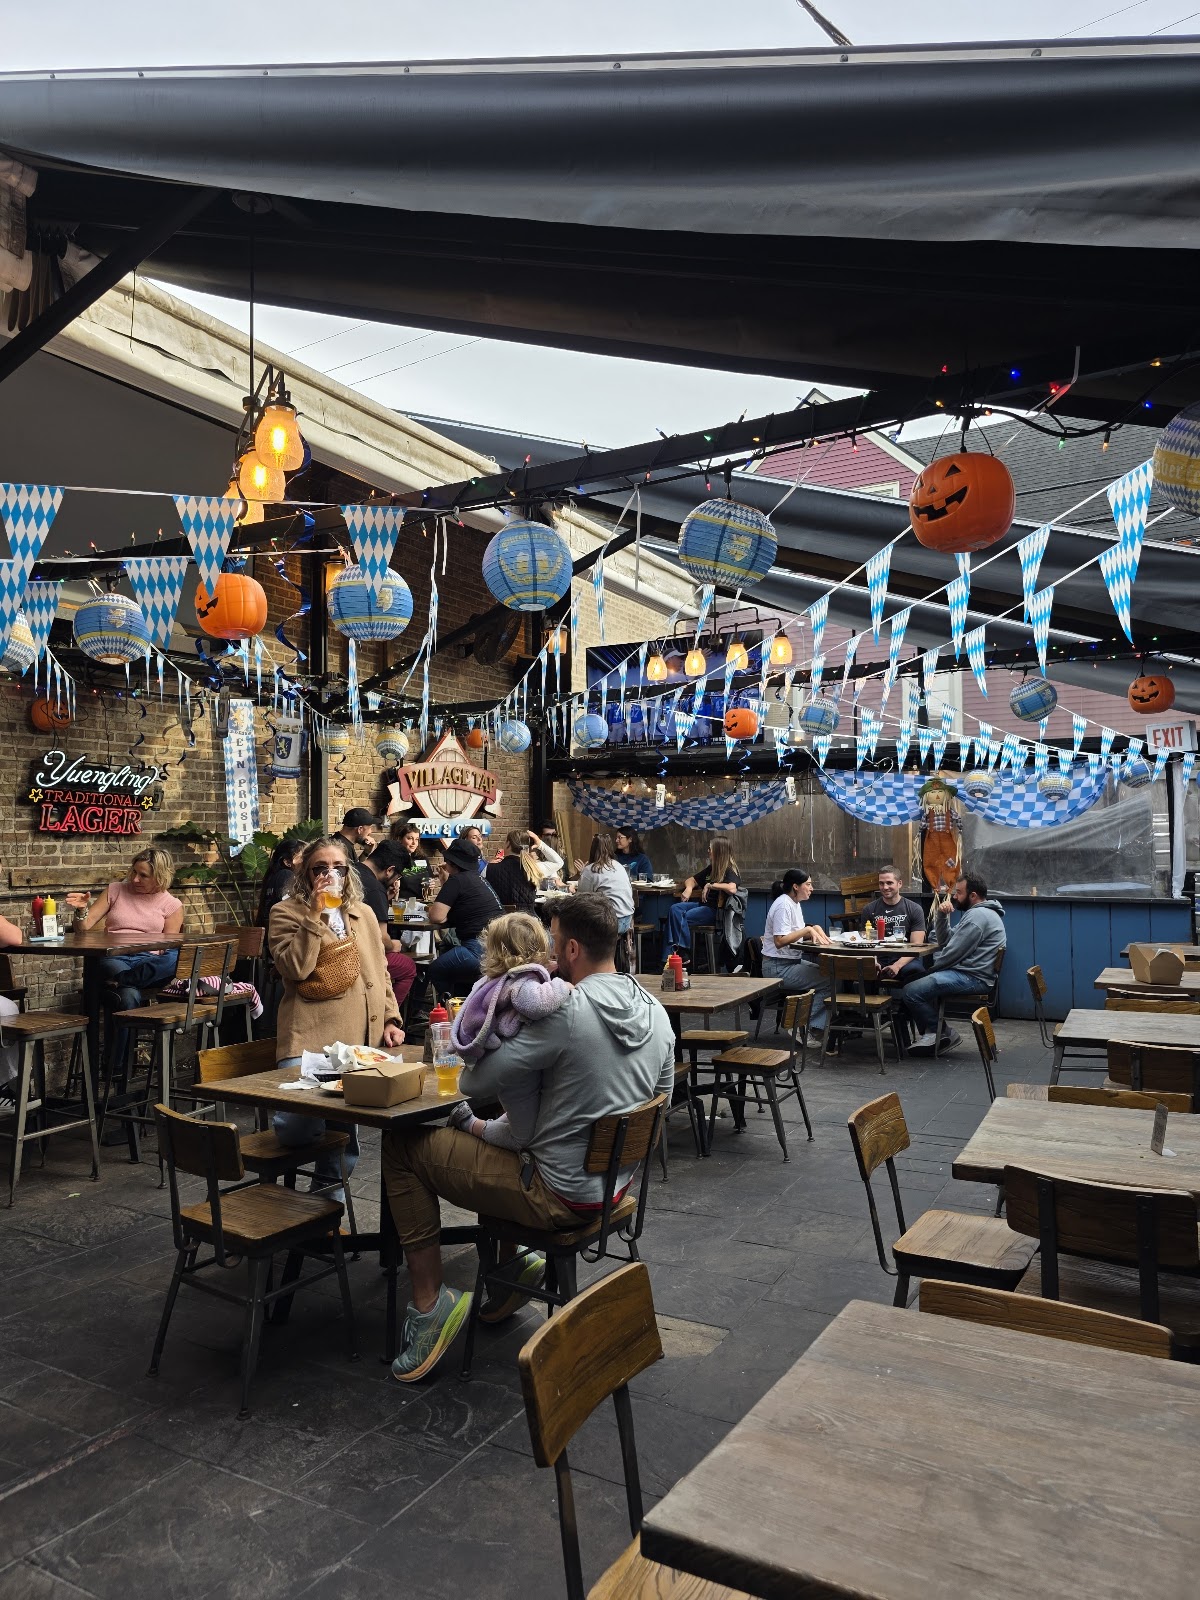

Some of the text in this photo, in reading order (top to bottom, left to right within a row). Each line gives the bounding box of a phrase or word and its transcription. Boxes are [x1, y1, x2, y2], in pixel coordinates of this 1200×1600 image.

[1152, 726, 1184, 749] EXIT
[236, 738, 246, 769] EIN
[35, 750, 158, 795] Yuengling
[404, 766, 496, 794] VILLAGE TAP
[44, 789, 141, 808] TRADITIONAL
[238, 778, 251, 843] PROSIT
[39, 803, 142, 834] LAGER
[442, 822, 452, 837] &
